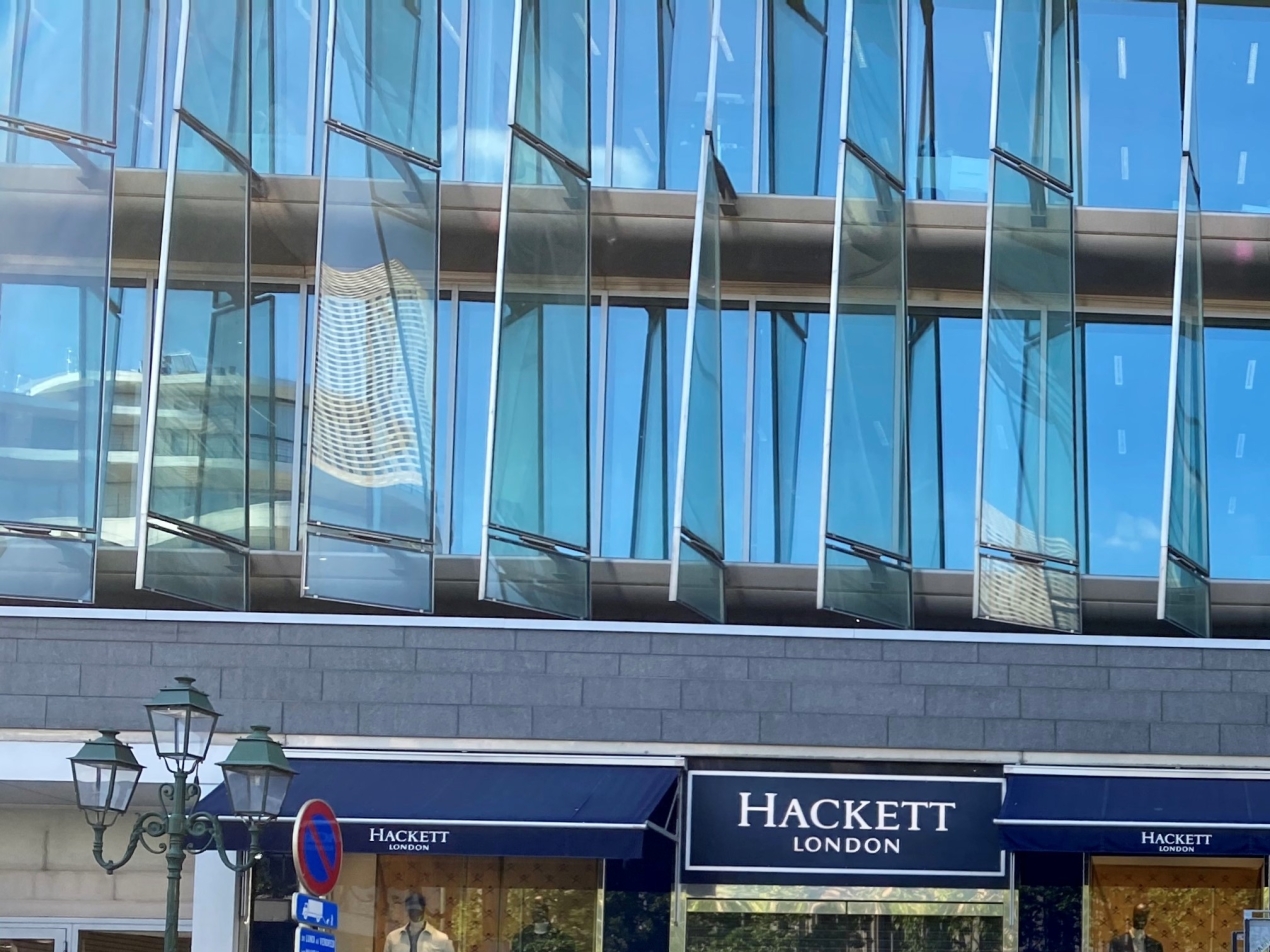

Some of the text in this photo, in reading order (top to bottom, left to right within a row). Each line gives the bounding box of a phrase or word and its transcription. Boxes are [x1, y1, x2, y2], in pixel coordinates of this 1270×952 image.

[738, 792, 956, 831] HACKETT
[369, 828, 449, 843] HACKETT
[1141, 832, 1212, 845] HACKETT
[793, 836, 900, 854] LONDON
